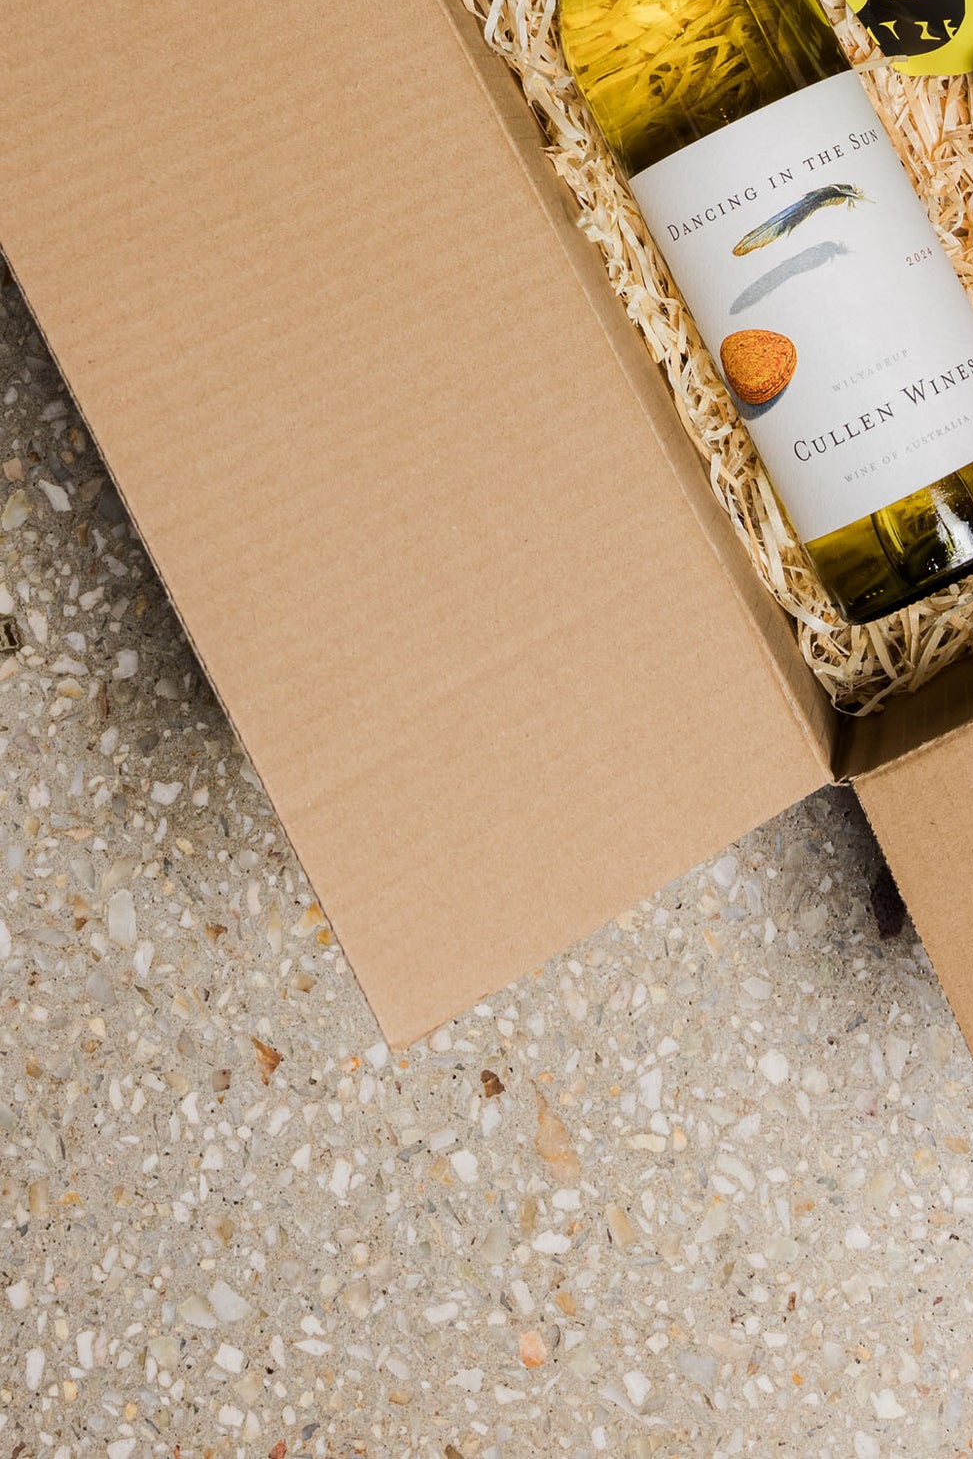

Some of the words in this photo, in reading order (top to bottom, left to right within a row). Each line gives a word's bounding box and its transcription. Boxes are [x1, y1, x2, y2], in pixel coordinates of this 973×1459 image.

[667, 187, 759, 242] DANCING
[768, 168, 794, 189] IN
[802, 145, 844, 171] THE
[848, 128, 879, 150] SUN
[905, 247, 933, 267] 2024
[832, 348, 909, 393] WILYABRUP
[793, 402, 895, 462] CULLEN
[844, 462, 879, 484] WINE
[881, 450, 899, 466] OF
[903, 414, 971, 455] AUSTRALIA
